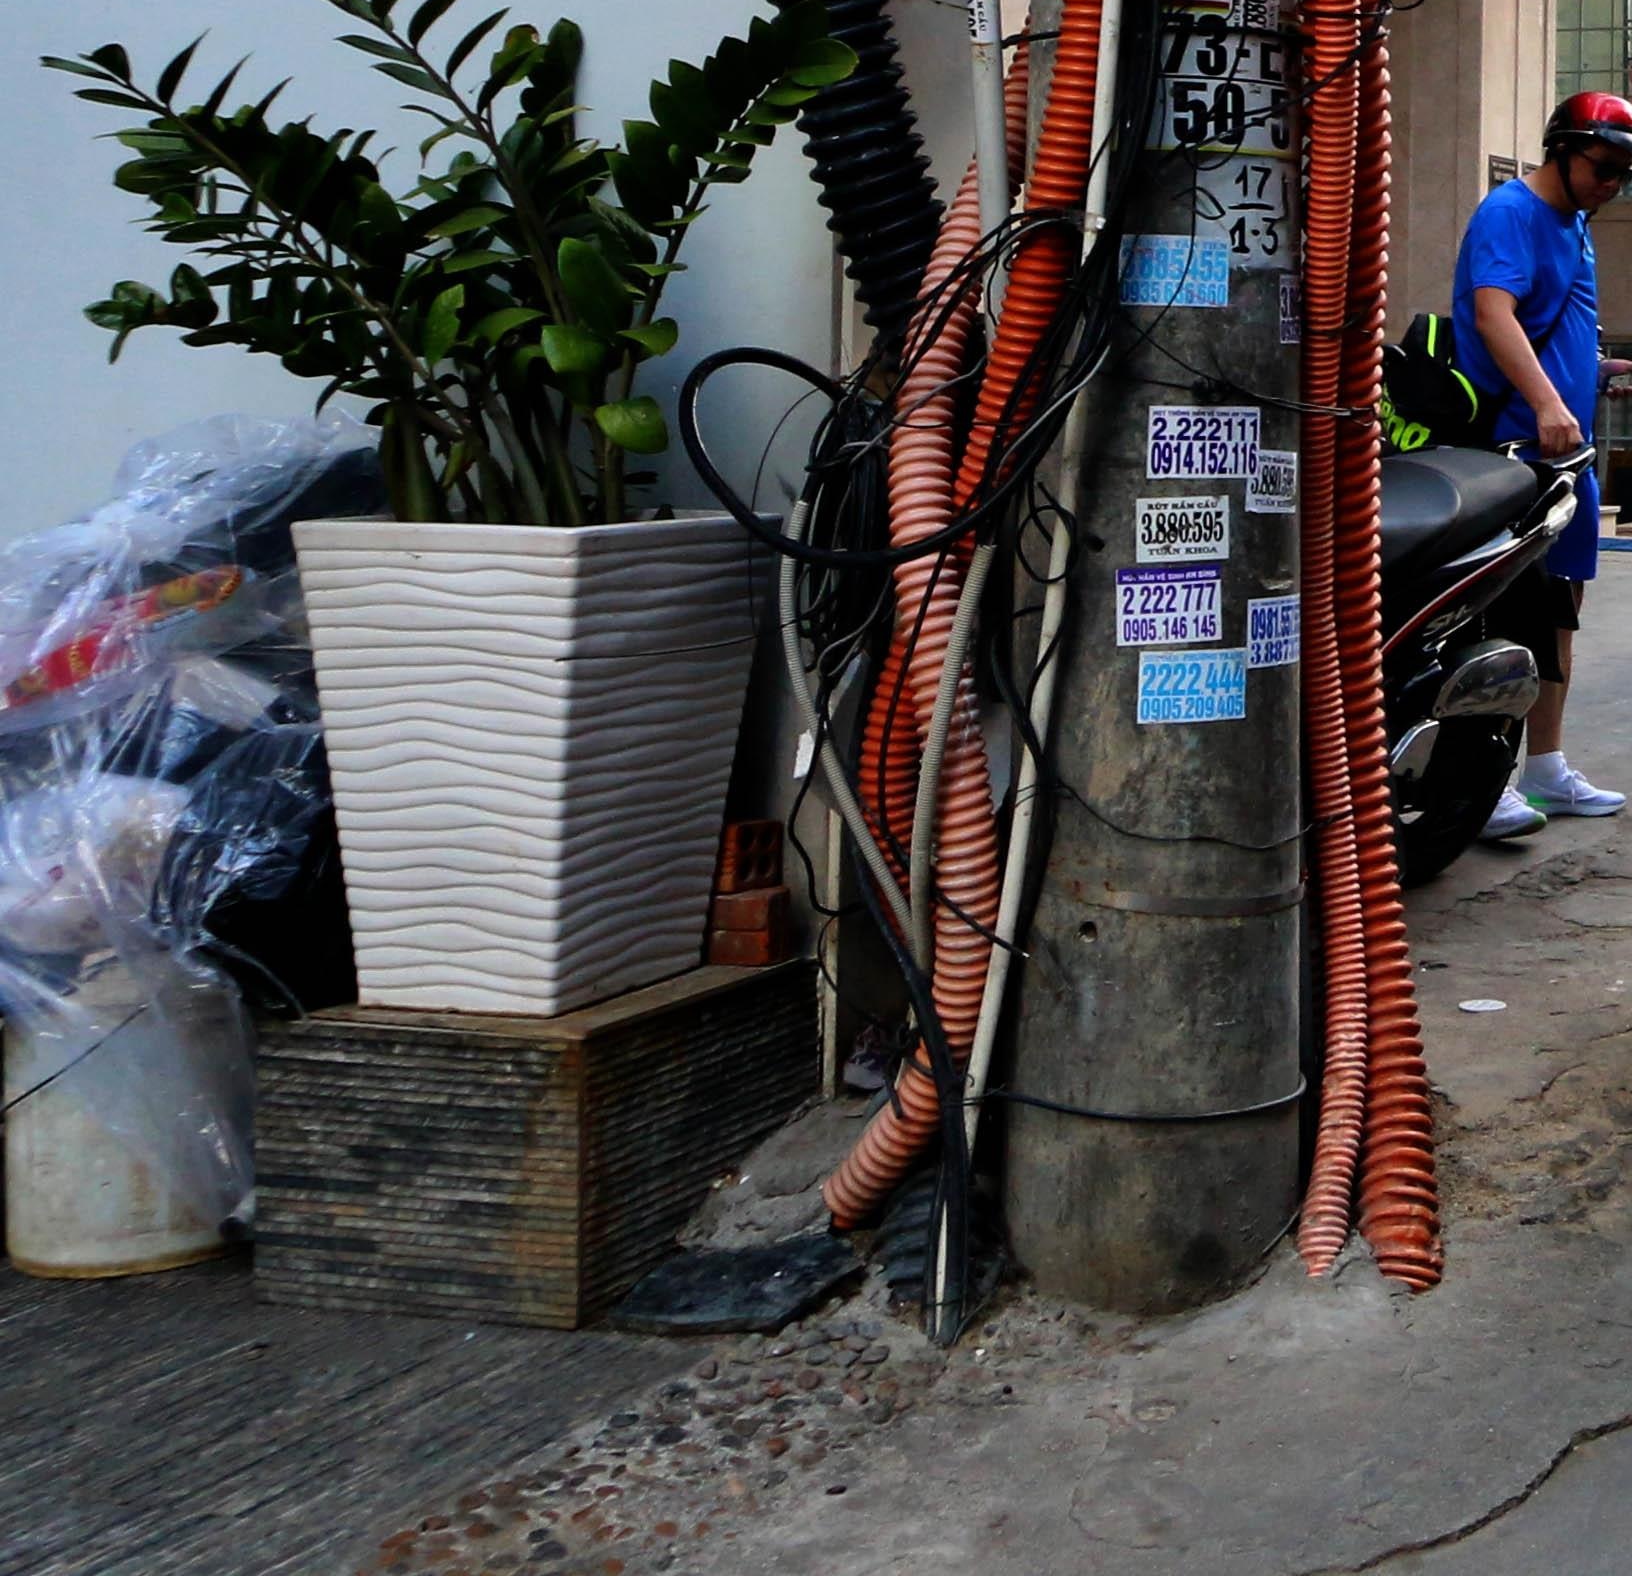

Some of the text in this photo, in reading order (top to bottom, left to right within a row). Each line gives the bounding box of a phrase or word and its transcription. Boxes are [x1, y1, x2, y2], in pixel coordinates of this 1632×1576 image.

[1235, 164, 1272, 199] 17
[1151, 416, 1258, 442] 2.222111
[1150, 441, 1258, 475] 0914.152.116
[1141, 510, 1224, 545] 3.880.595
[1185, 545, 1218, 556] KHOA
